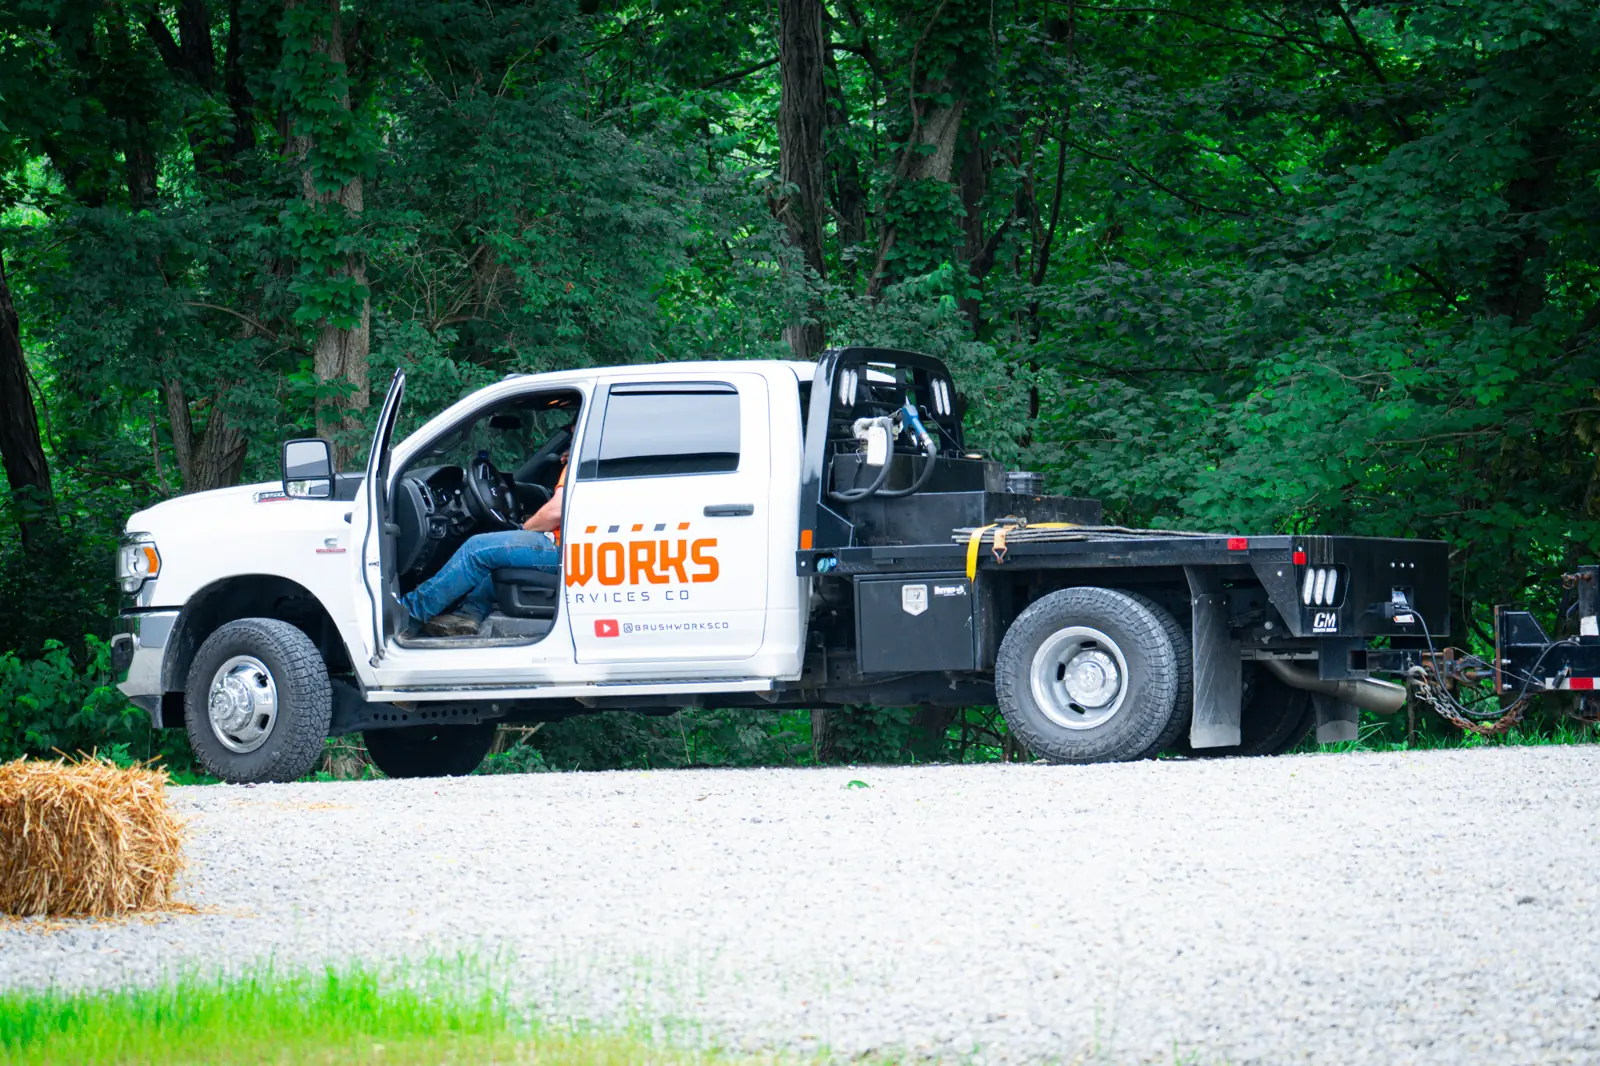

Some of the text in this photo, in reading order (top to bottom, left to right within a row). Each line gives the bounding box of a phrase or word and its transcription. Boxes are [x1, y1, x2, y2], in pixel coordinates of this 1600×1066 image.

[565, 538, 720, 588] WORKS
[665, 590, 690, 601] CO
[1313, 612, 1336, 628] CM
